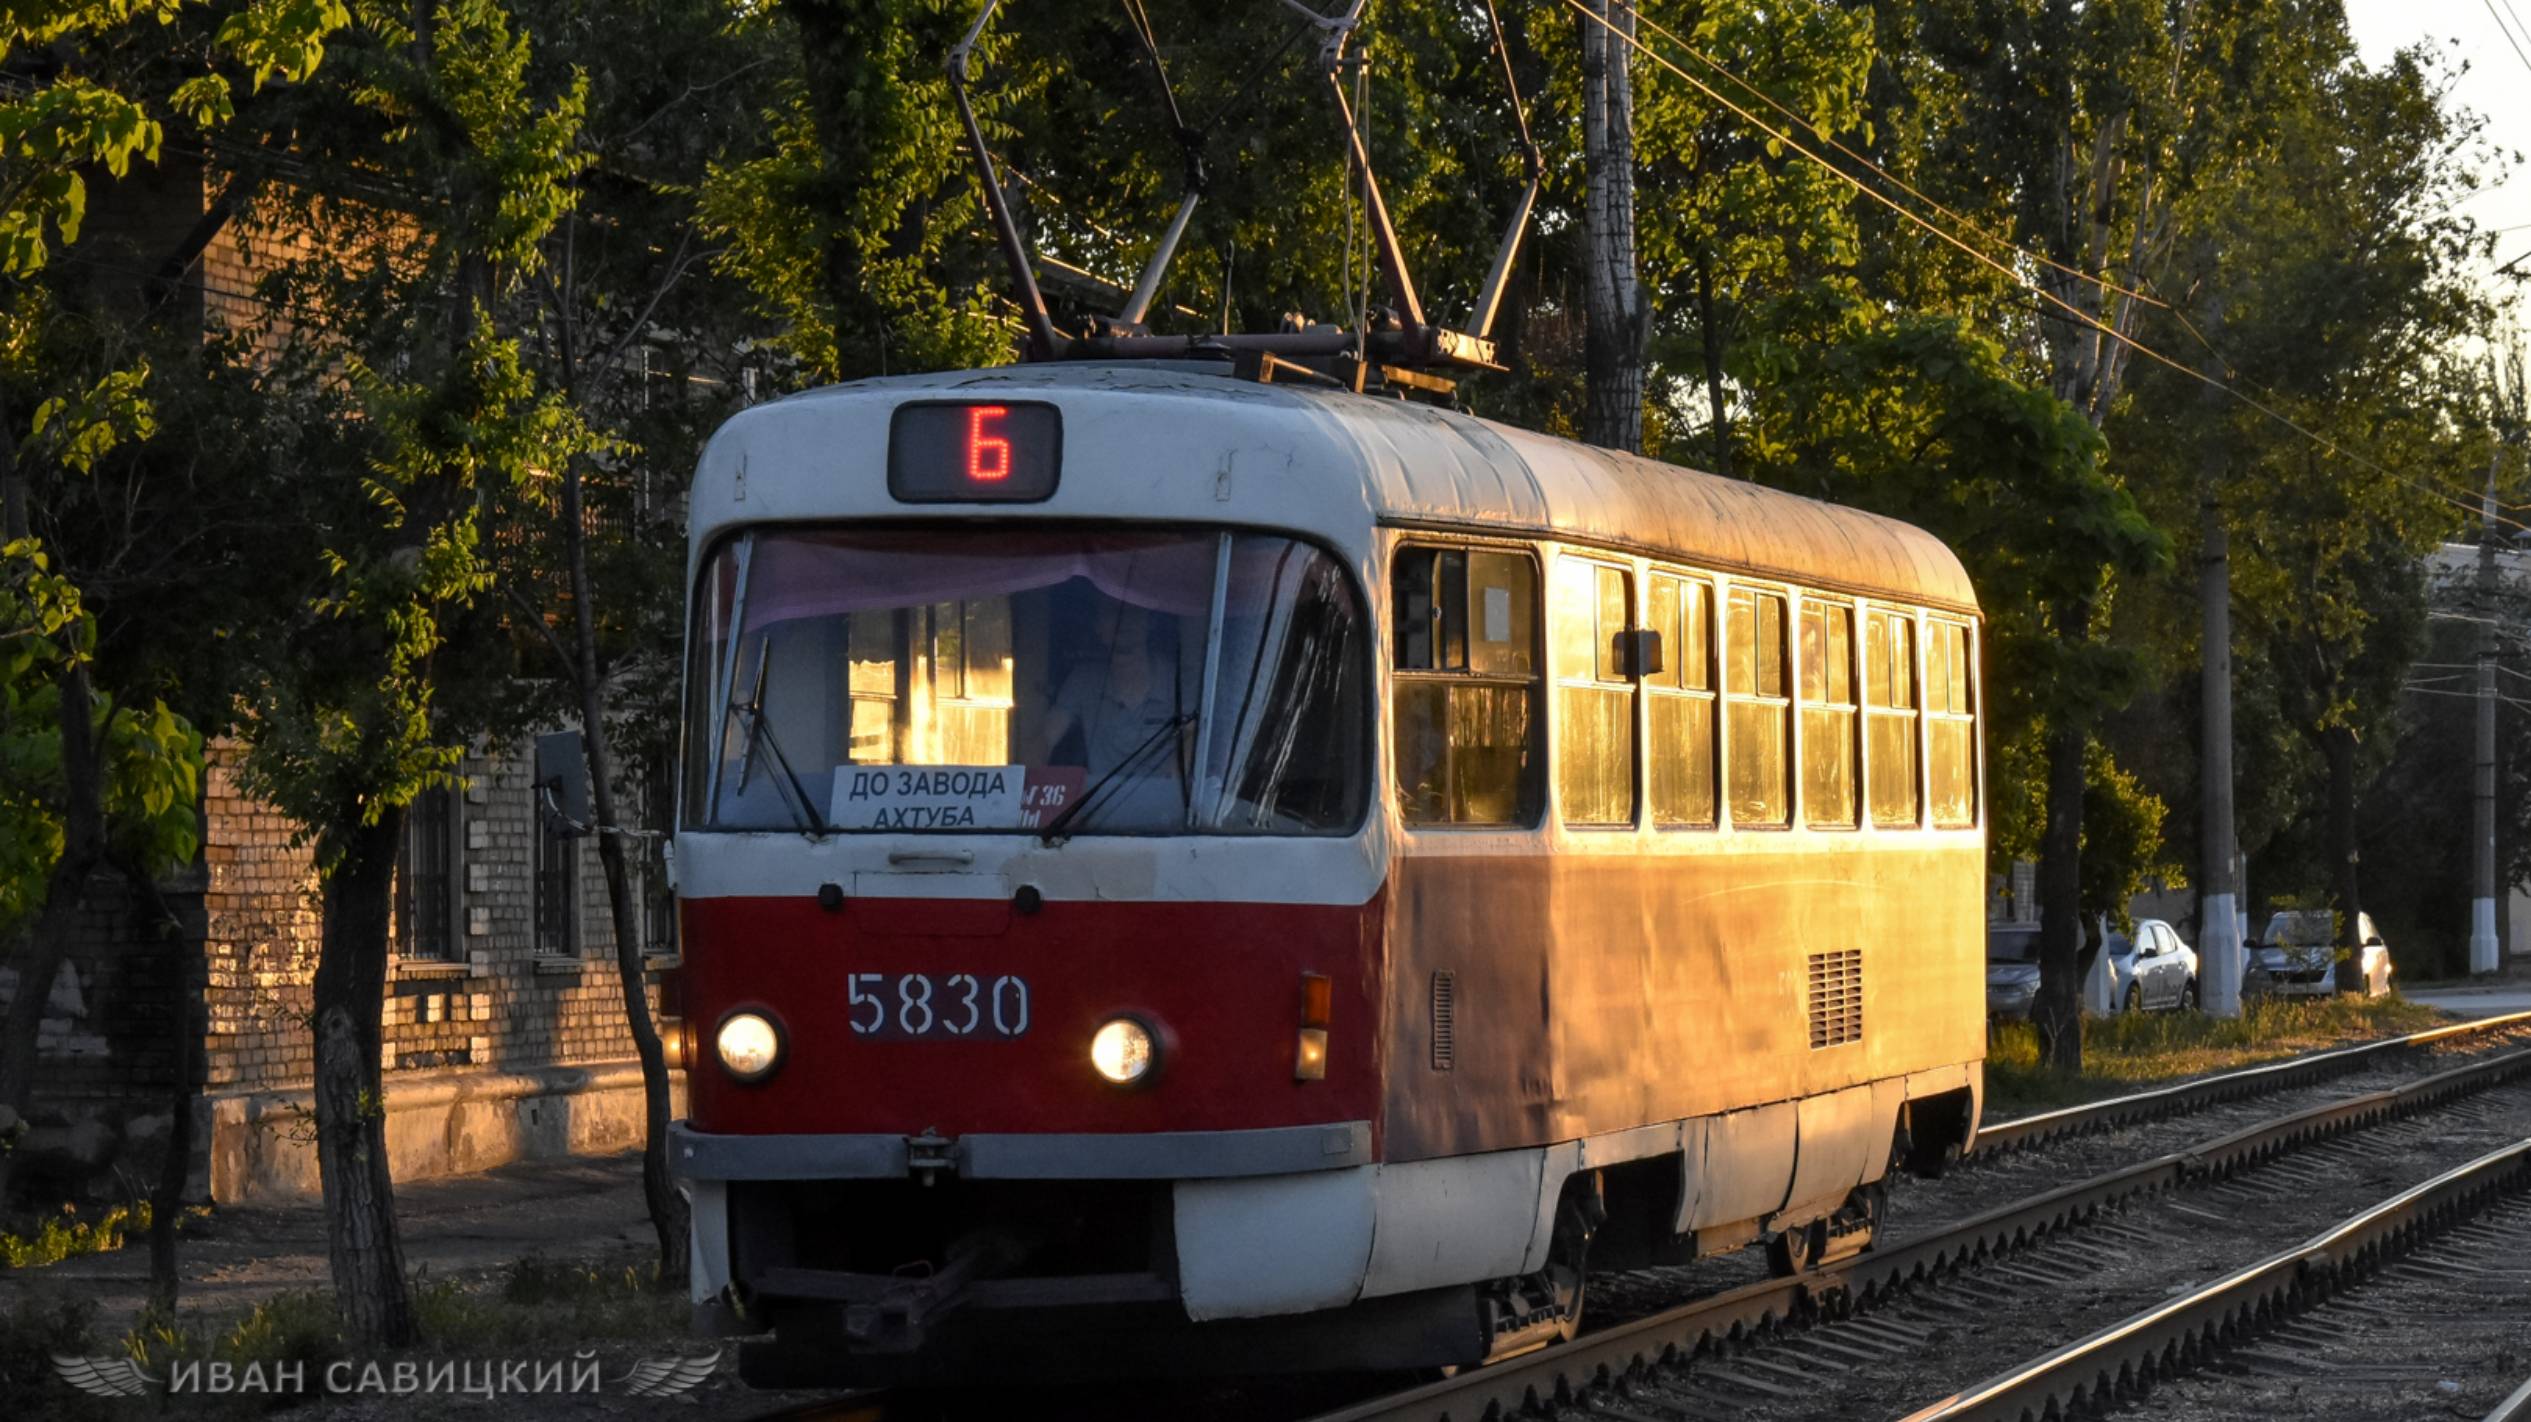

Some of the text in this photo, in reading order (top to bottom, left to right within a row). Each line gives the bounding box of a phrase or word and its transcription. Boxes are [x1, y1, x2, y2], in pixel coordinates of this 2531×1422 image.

[969, 406, 1008, 479] 6
[850, 772, 889, 800] ДО
[896, 772, 1006, 799] ЗАВОДА
[1040, 785, 1066, 806] 36
[873, 806, 975, 829] АХТУБА
[848, 973, 1028, 1035] 5830
